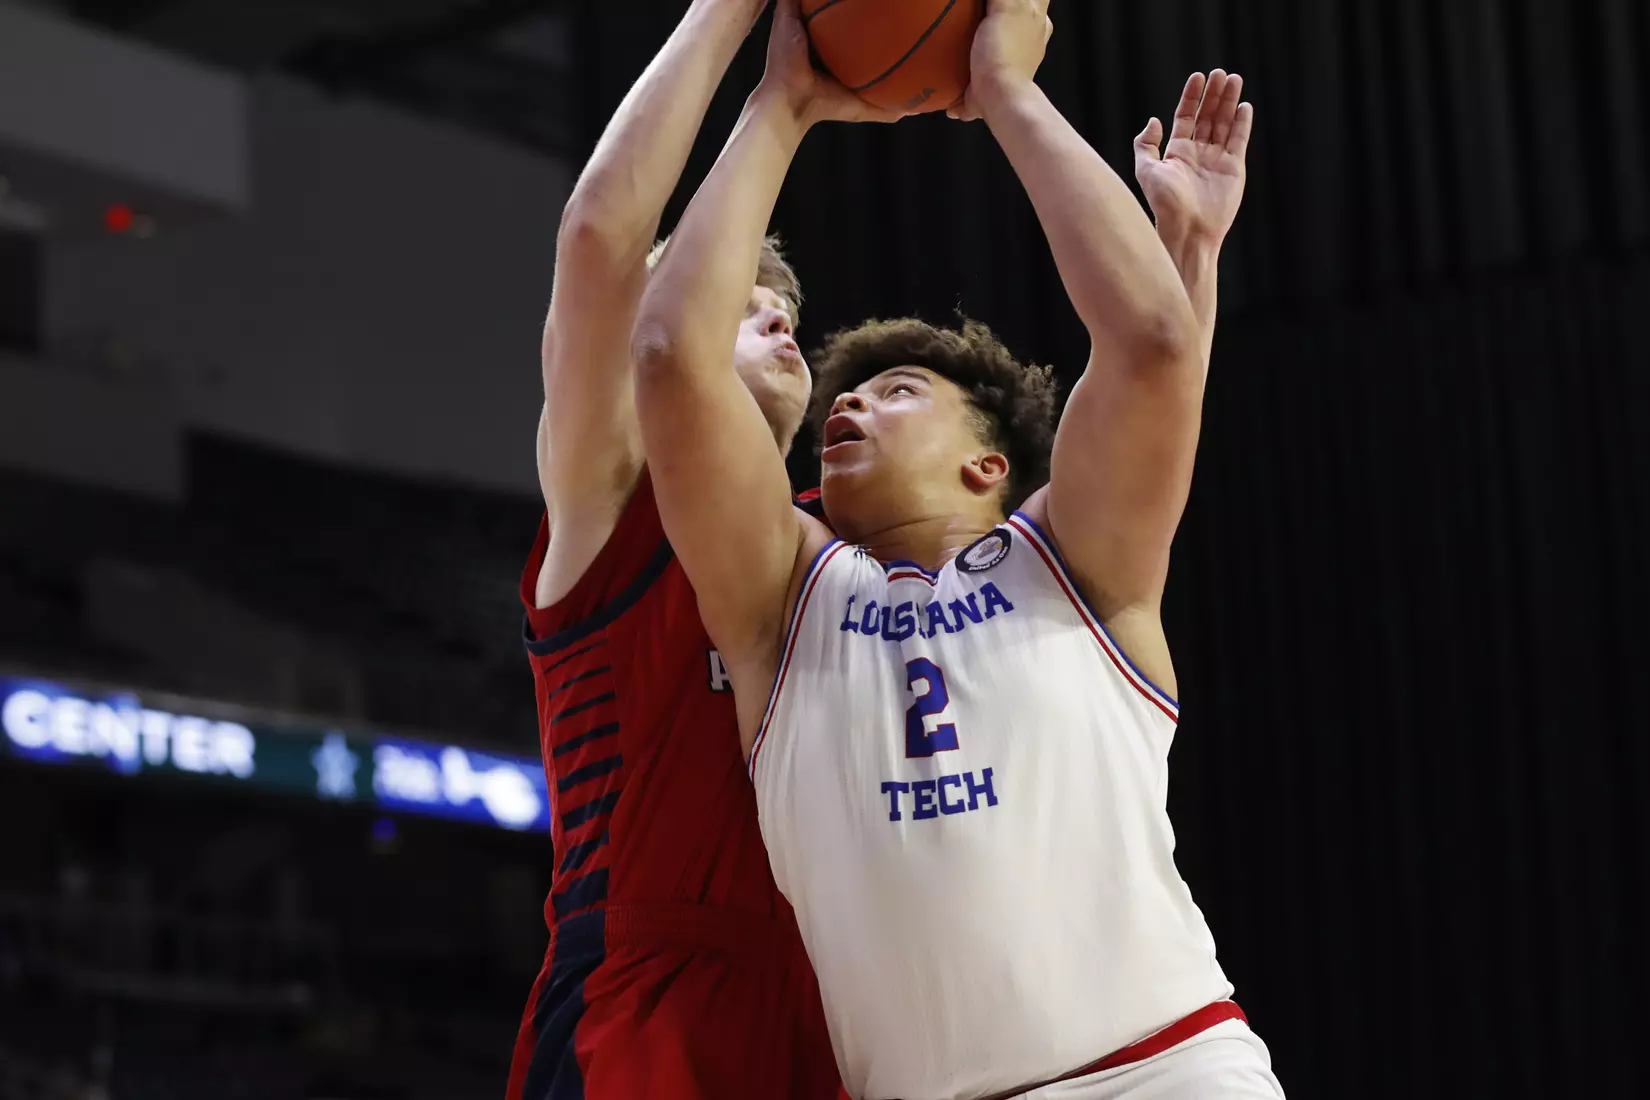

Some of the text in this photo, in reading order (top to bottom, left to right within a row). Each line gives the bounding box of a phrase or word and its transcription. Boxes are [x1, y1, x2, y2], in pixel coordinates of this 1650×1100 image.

[840, 582, 1014, 641] LOUSANA
[2, 689, 255, 779] CENTER
[905, 657, 960, 758] 2
[881, 767, 999, 821] TECH
